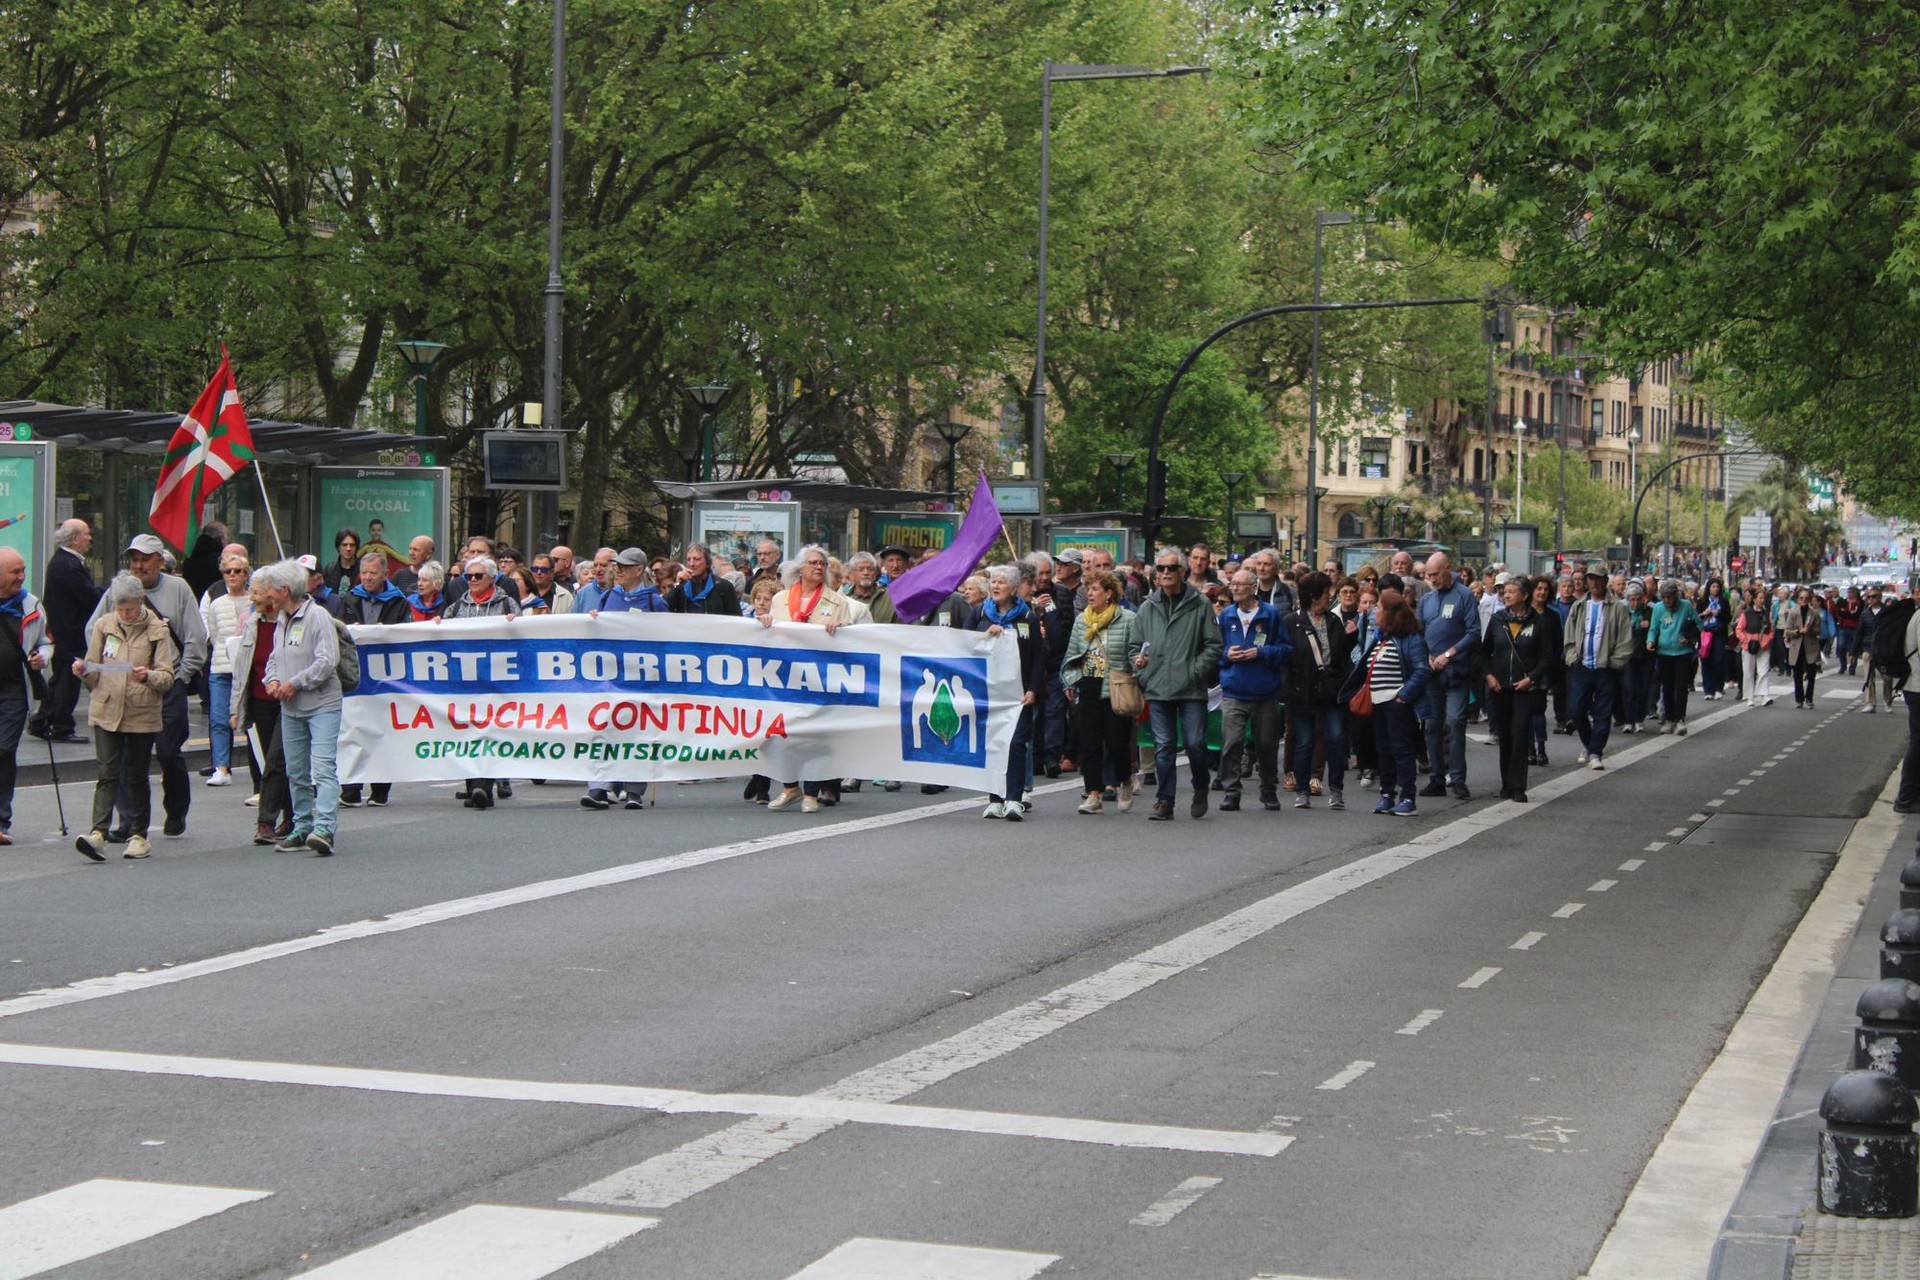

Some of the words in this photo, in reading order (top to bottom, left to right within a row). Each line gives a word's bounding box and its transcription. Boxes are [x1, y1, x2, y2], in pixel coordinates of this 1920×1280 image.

[19, 426, 26, 436] 5
[345, 499, 410, 512] COLOSAL
[882, 524, 945, 549] IMPACTA
[367, 651, 520, 682] URTE
[537, 651, 866, 694] BORROKAN
[389, 701, 434, 730] LA
[449, 701, 569, 731] LUCHA
[587, 701, 788, 739] CONTINUA
[415, 739, 566, 760] GIPUZKOAKO
[573, 741, 759, 762] PENTSIODUNAK
